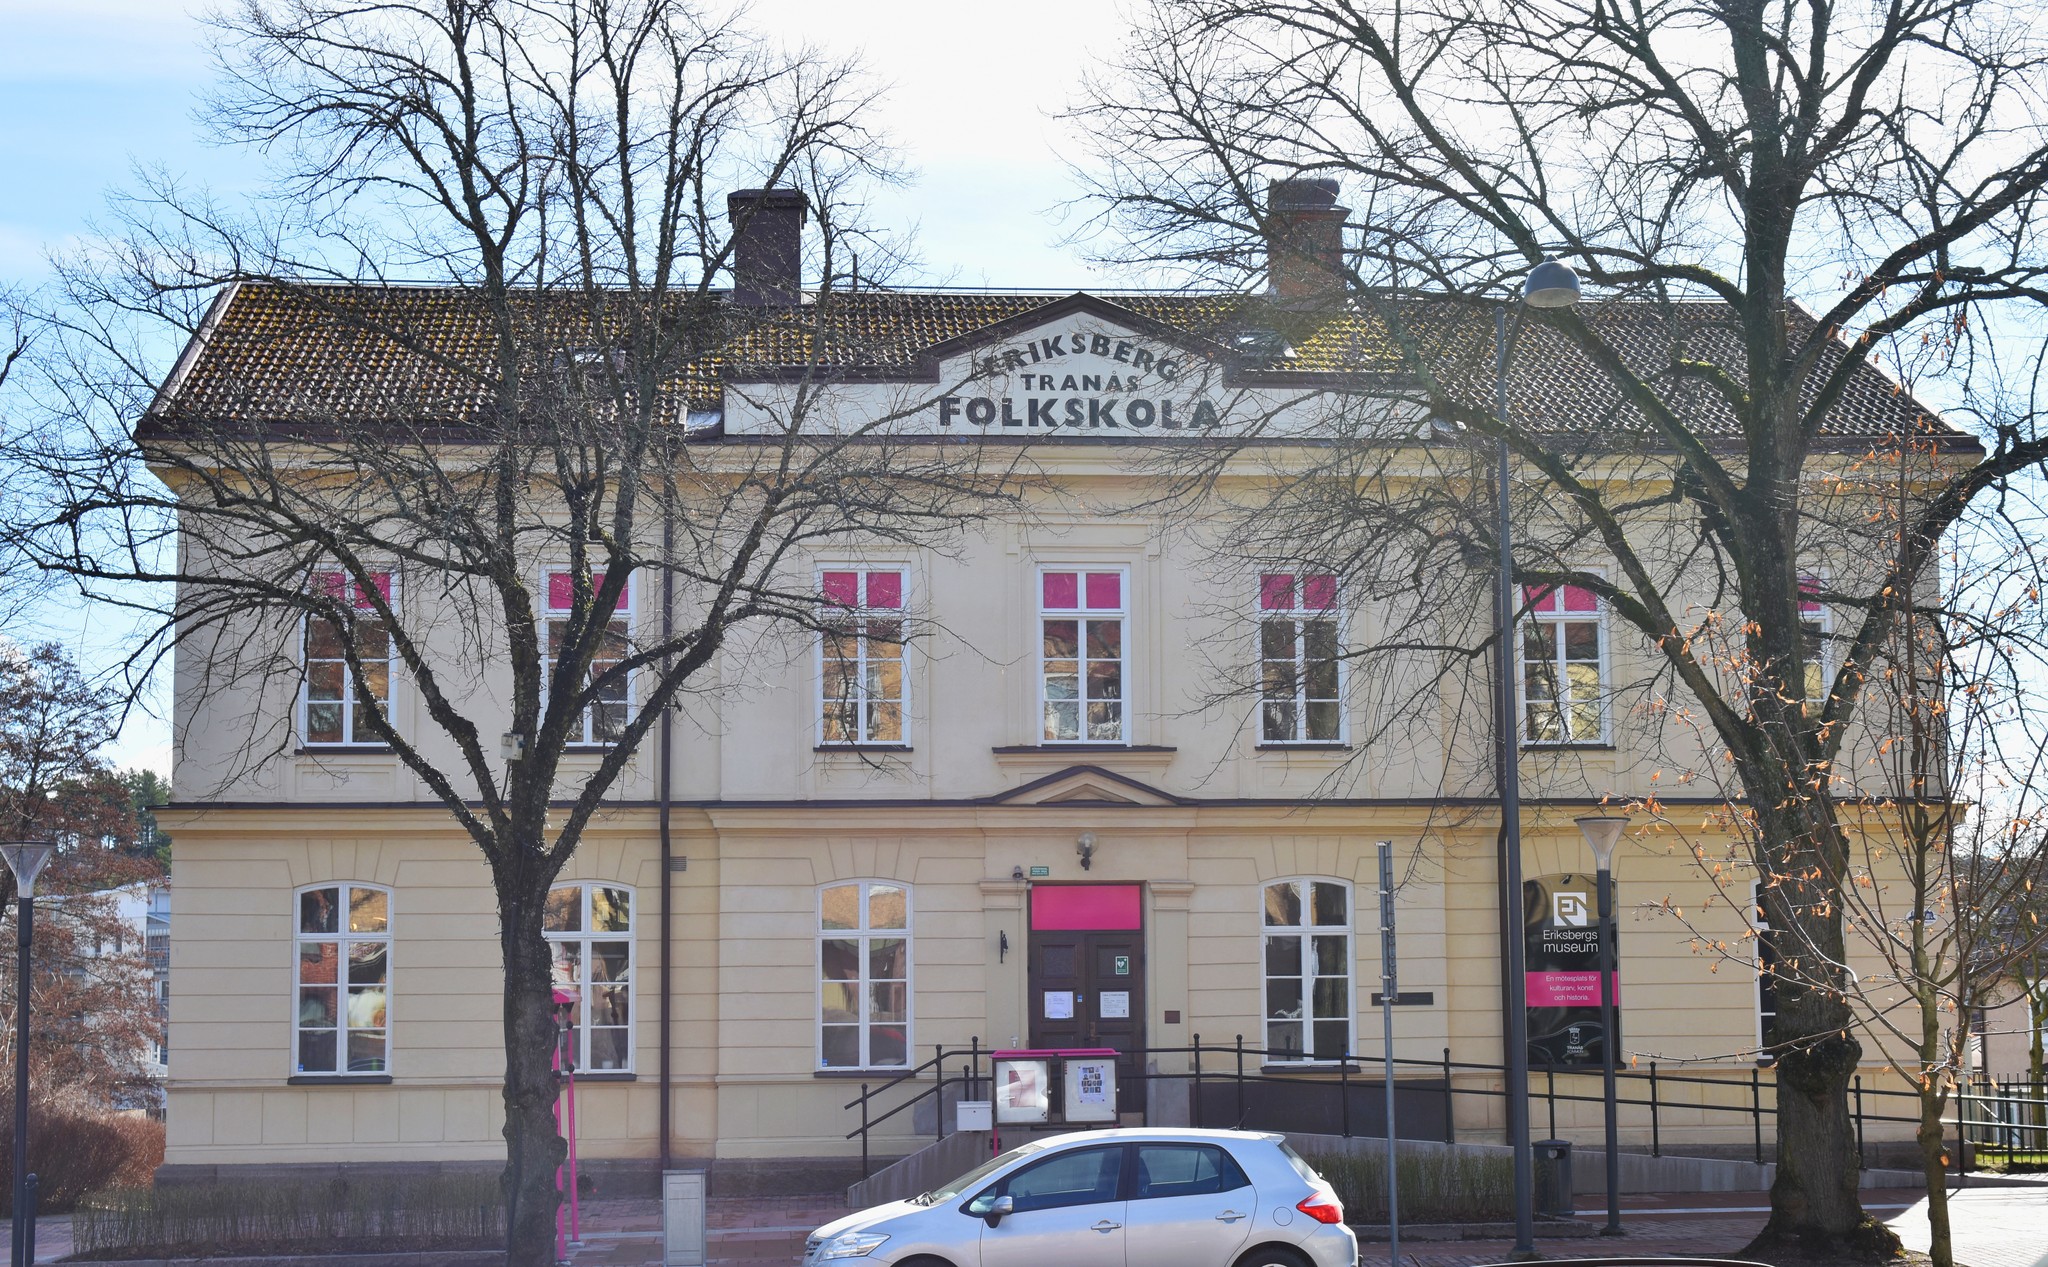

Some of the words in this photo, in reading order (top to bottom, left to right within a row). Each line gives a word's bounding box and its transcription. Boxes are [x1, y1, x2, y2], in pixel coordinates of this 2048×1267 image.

[1020, 370, 1139, 392] TRANÅS
[939, 397, 1221, 429] FOLKSKOLA
[1543, 929, 1598, 942] Eriksbergs
[1543, 943, 1598, 953] museum
